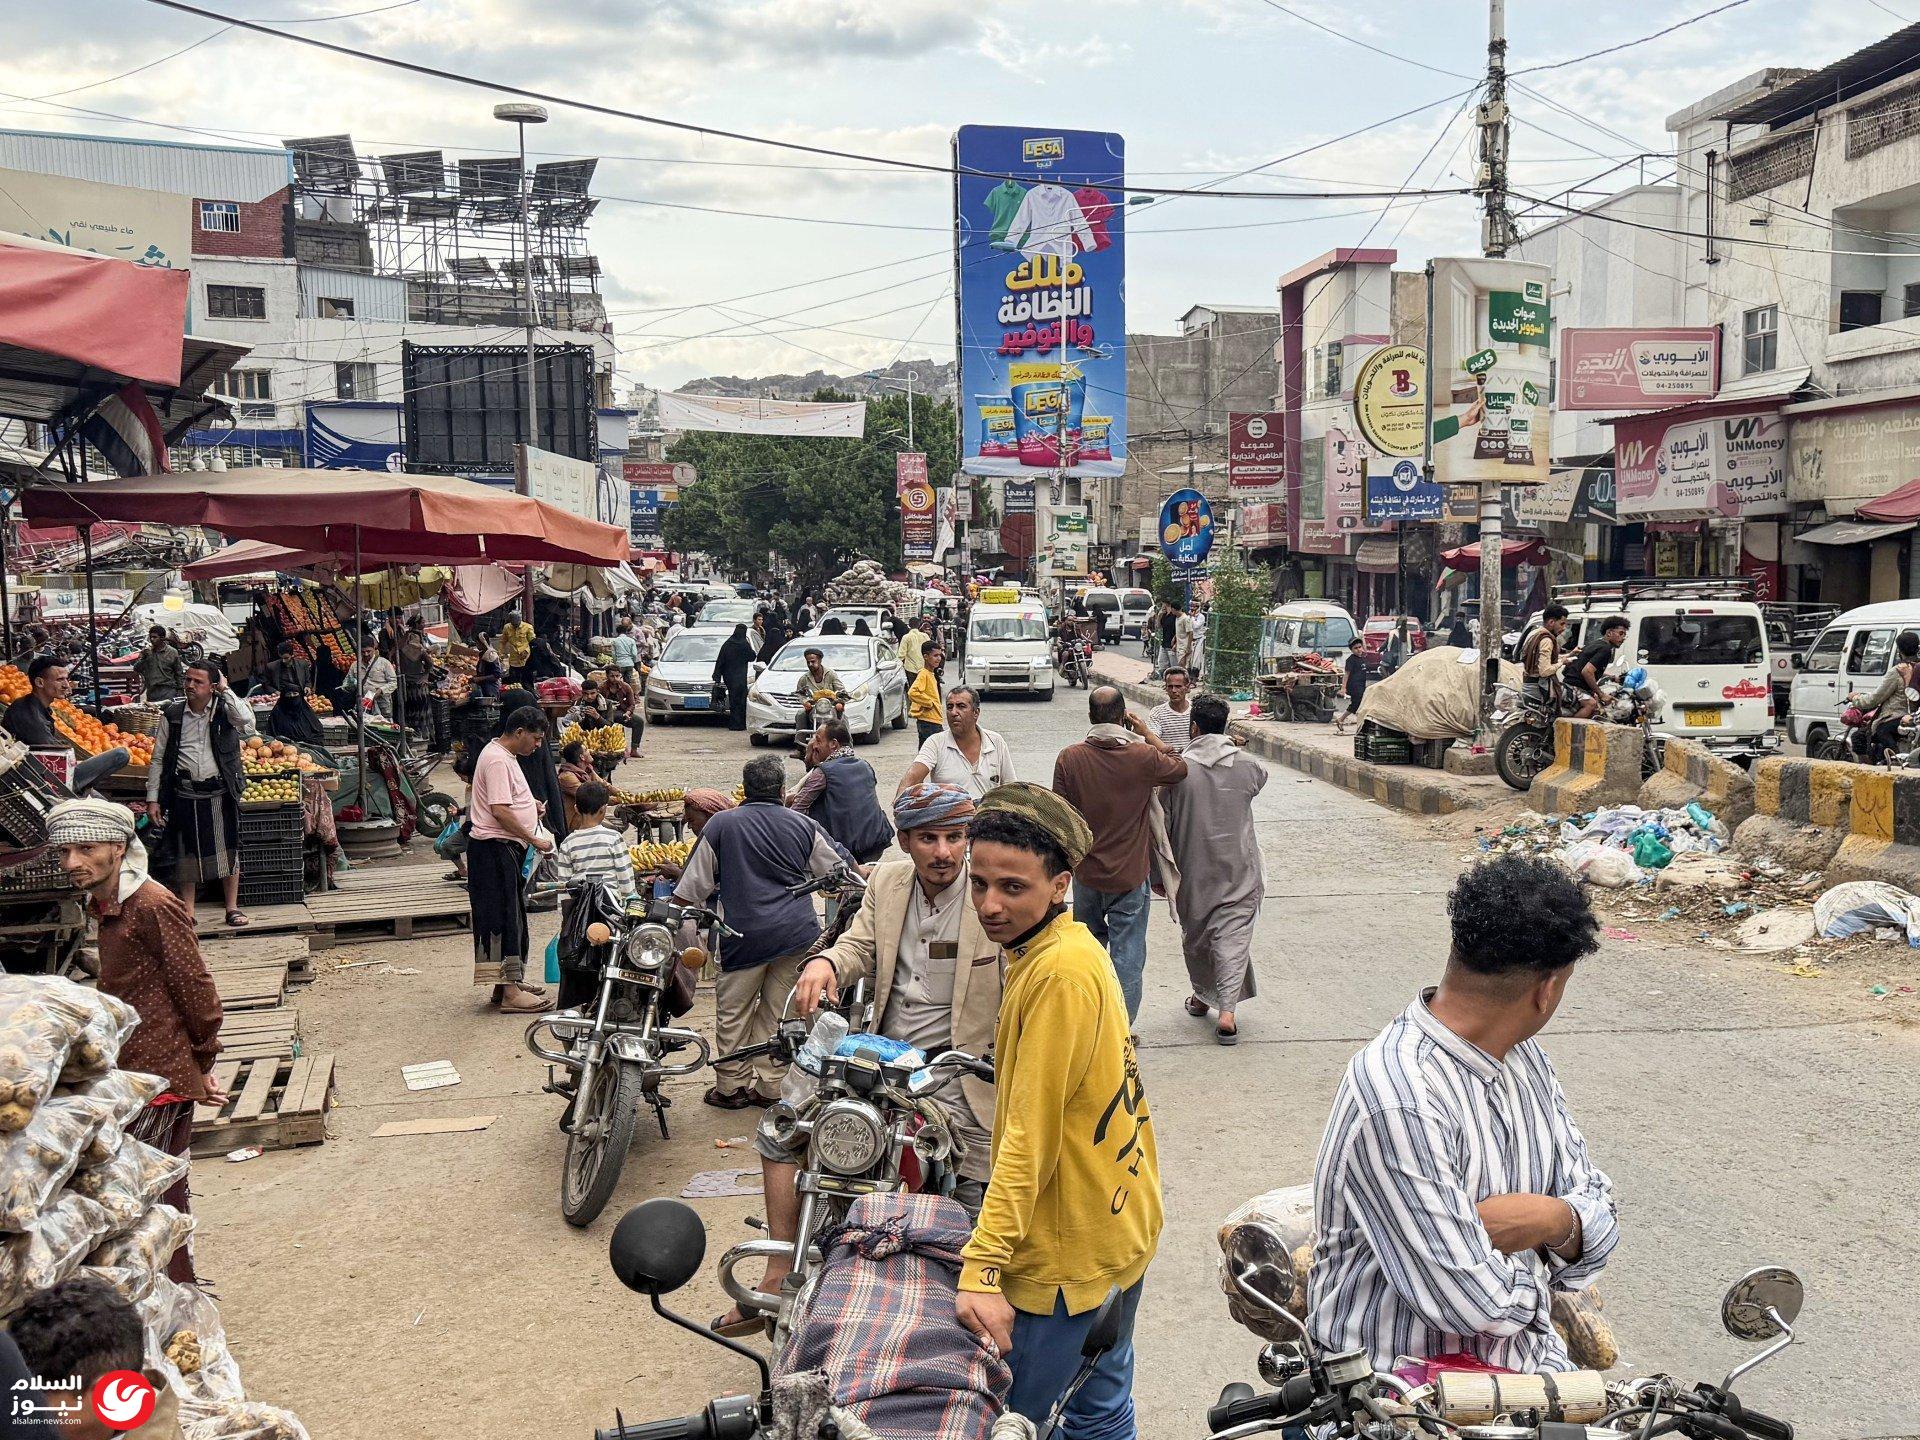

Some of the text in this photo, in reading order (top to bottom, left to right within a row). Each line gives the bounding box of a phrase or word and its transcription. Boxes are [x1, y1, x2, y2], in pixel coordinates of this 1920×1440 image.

[1025, 141, 1061, 156] LEGA
[70, 220, 134, 235] ماء طبيعي نقي
[1005, 254, 1083, 291] ملك
[998, 286, 1091, 323] النظافة
[1513, 305, 1536, 320] عبوات
[1492, 317, 1519, 336] الجديدة
[996, 318, 1093, 355] والتوفير
[1382, 350, 1404, 364] للصرافة
[1485, 352, 1495, 365] 5
[1653, 347, 1709, 366] الأيوبي
[1391, 369, 1410, 392] B
[1641, 369, 1708, 378] للصرافة والتحويلات
[1363, 363, 1383, 400] والتحويلات
[1240, 441, 1275, 450] مجموعة
[1387, 442, 1409, 451] COMPANY
[1670, 428, 1709, 459] الأيوبي
[1726, 437, 1785, 453] UNMoney
[1231, 451, 1284, 461] الطاهري التجارية
[1671, 459, 1710, 472] للصرافة
[1620, 468, 1655, 485] UNMoney
[1671, 472, 1711, 485] والتحويلات
[1725, 465, 1783, 492] الأيوبي
[1432, 494, 1440, 504] من
[1675, 486, 1705, 498] 04-250895
[1726, 491, 1778, 505] والتحويلات
[1402, 495, 1409, 506] في
[1410, 494, 1425, 505] يشارك
[1179, 539, 1193, 552] أصل
